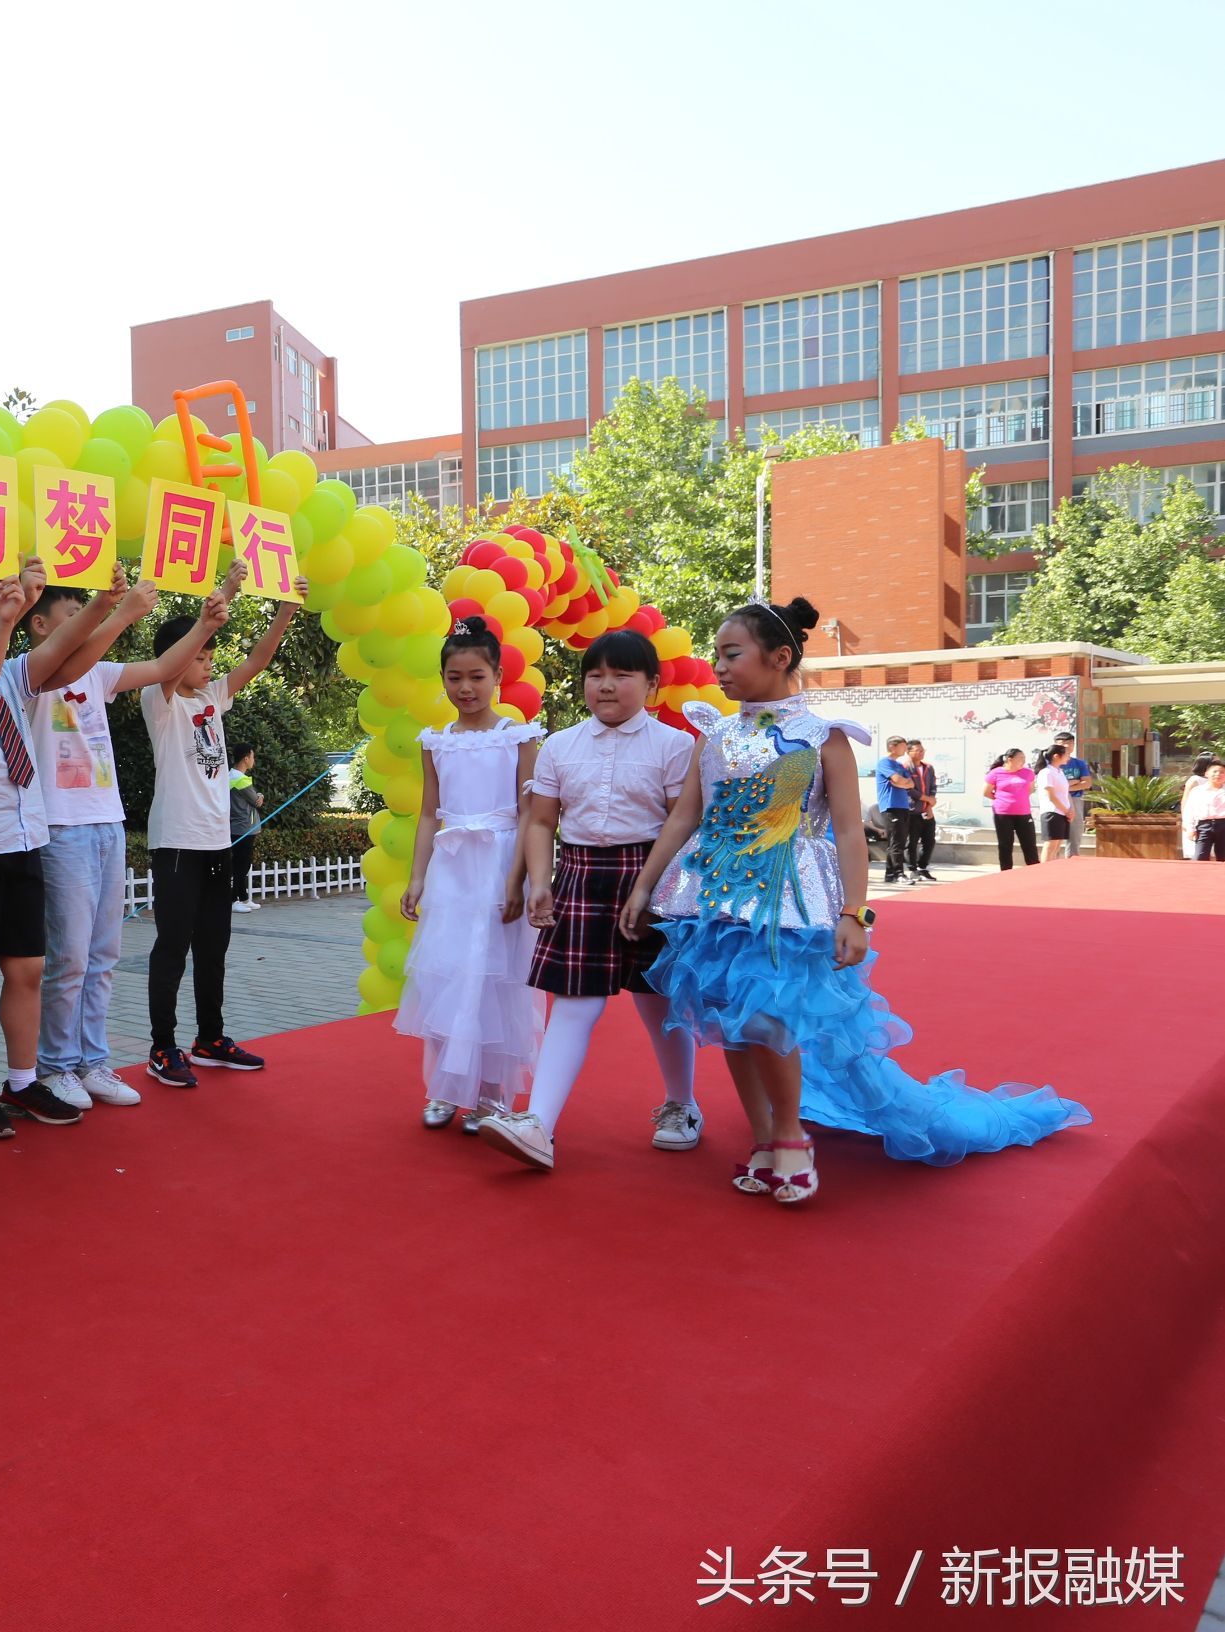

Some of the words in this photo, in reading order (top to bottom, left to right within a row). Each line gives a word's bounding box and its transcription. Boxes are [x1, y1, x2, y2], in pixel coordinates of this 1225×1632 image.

[45, 479, 112, 578] 梦
[153, 492, 216, 583] 同
[240, 512, 293, 594] 行
